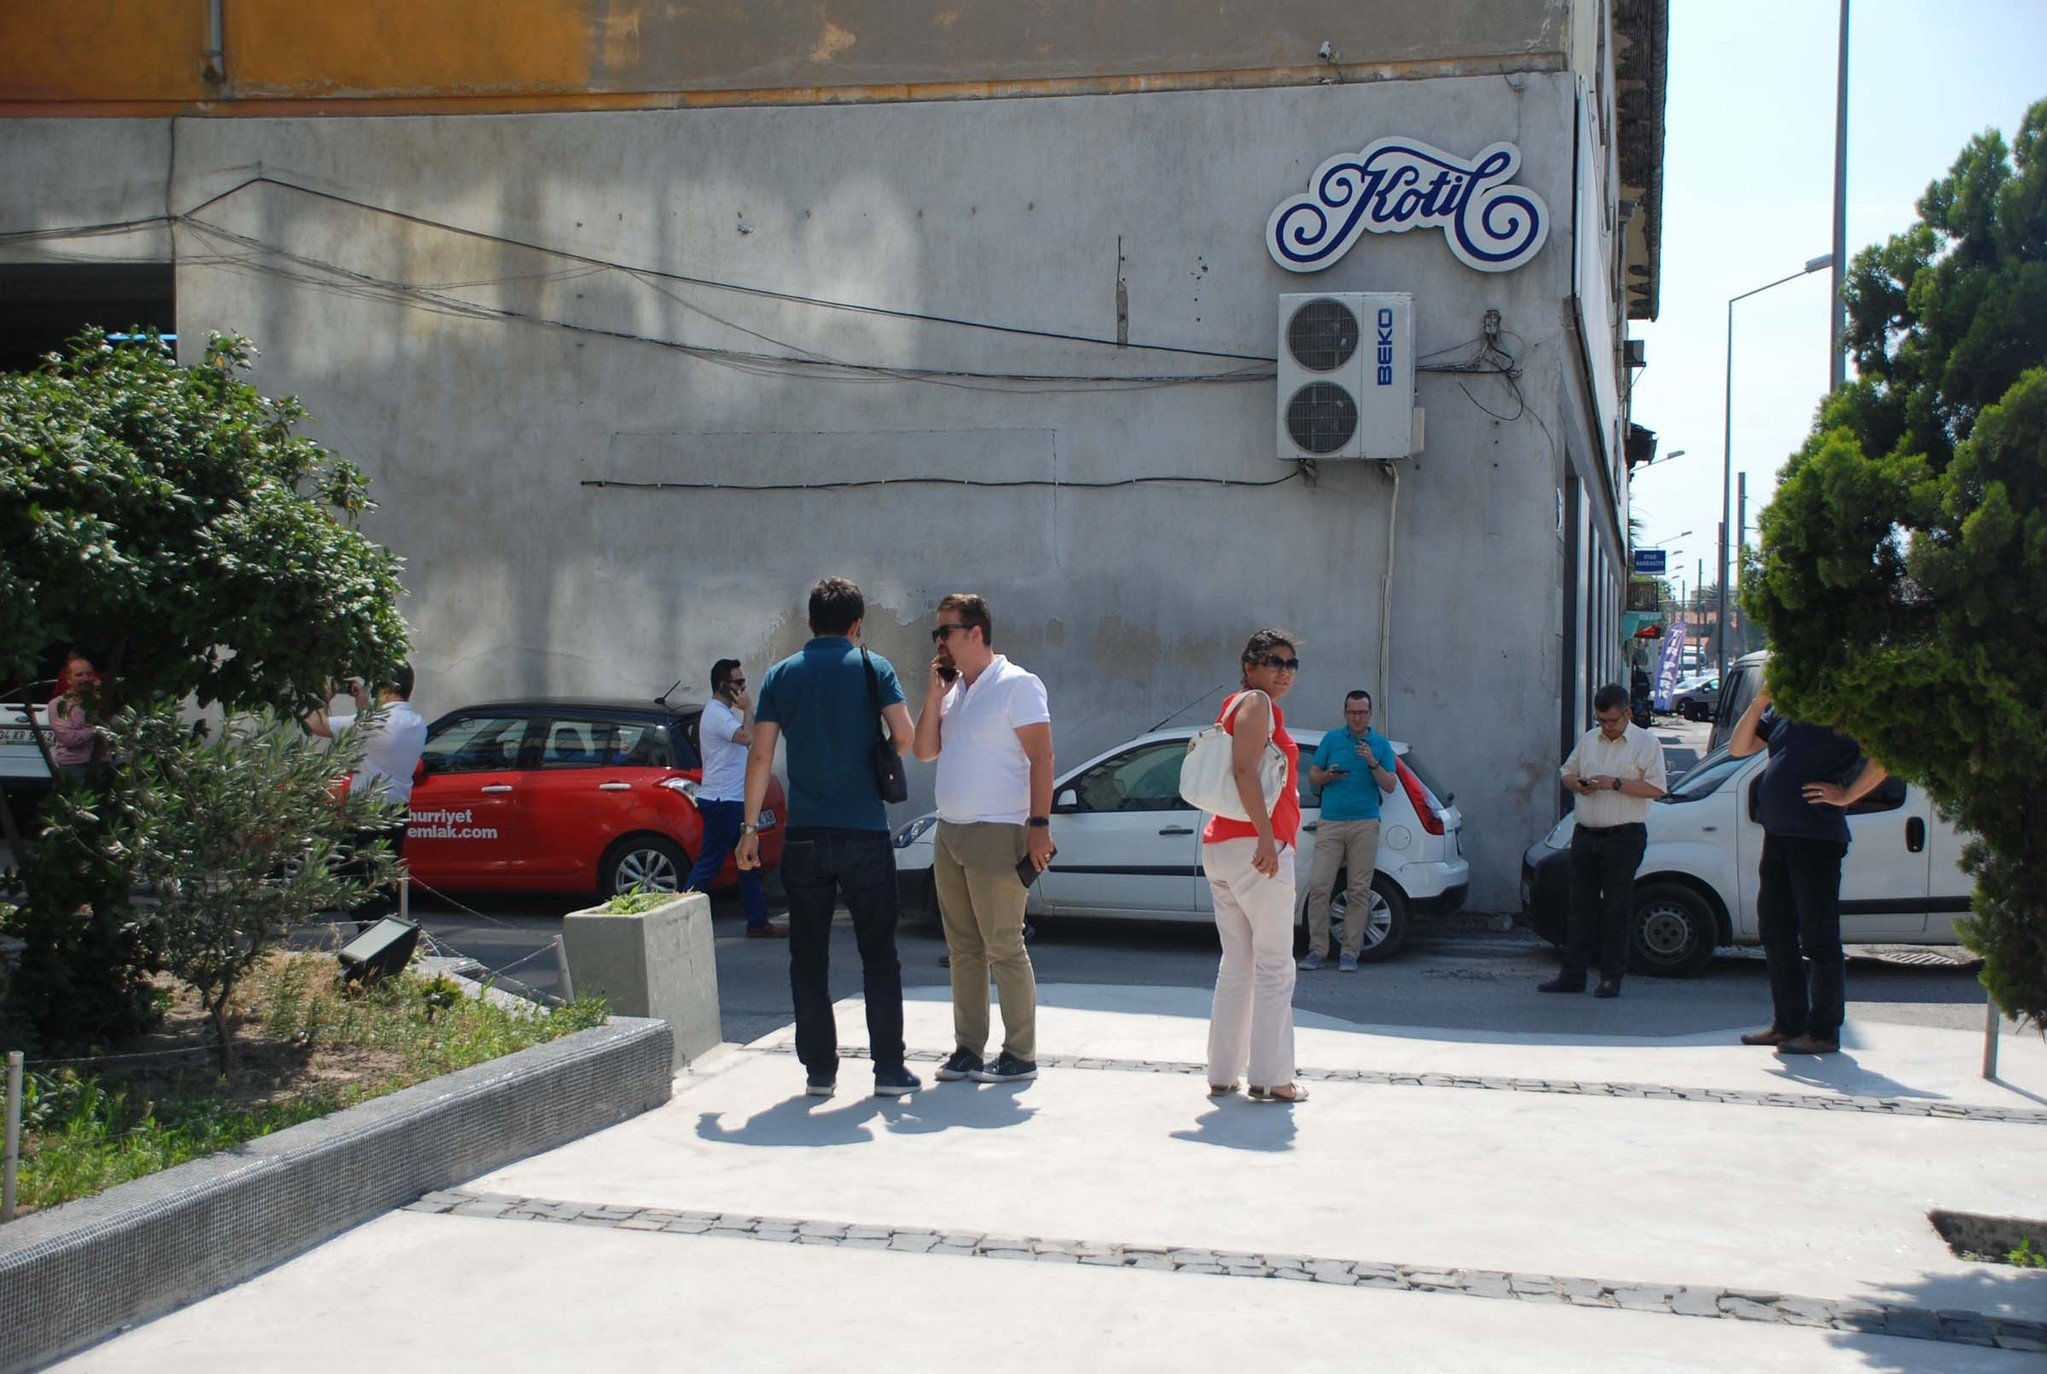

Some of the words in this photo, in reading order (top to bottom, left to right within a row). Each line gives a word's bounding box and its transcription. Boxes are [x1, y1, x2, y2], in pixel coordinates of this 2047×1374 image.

[1377, 307, 1393, 386] BEKO
[408, 808, 473, 825] hurriyet
[407, 824, 498, 839] emlak.com
